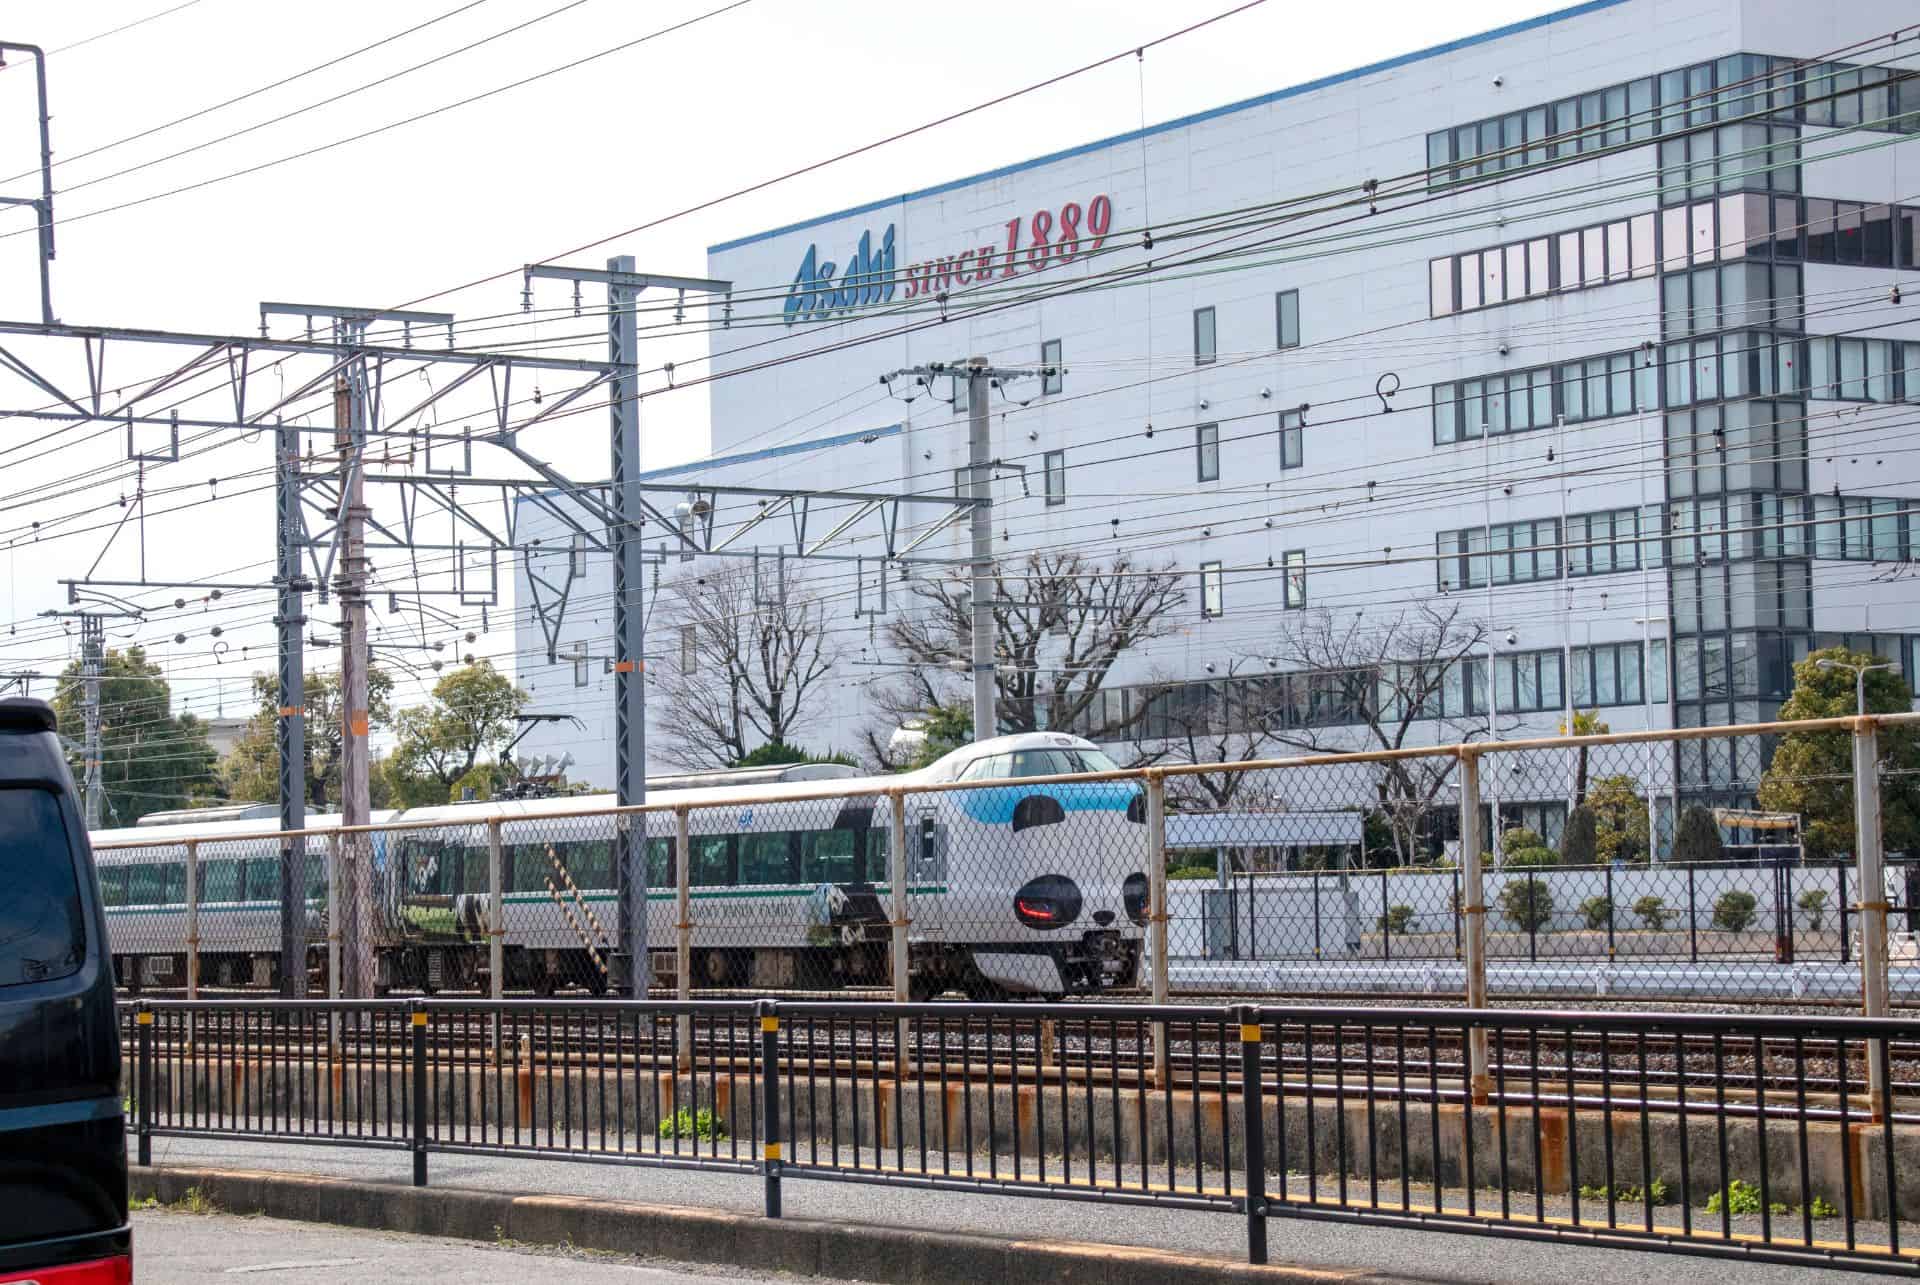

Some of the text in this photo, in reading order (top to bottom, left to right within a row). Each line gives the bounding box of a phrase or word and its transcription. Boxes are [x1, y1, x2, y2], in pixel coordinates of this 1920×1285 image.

[784, 194, 1110, 323] Asahi SINCE 1889
